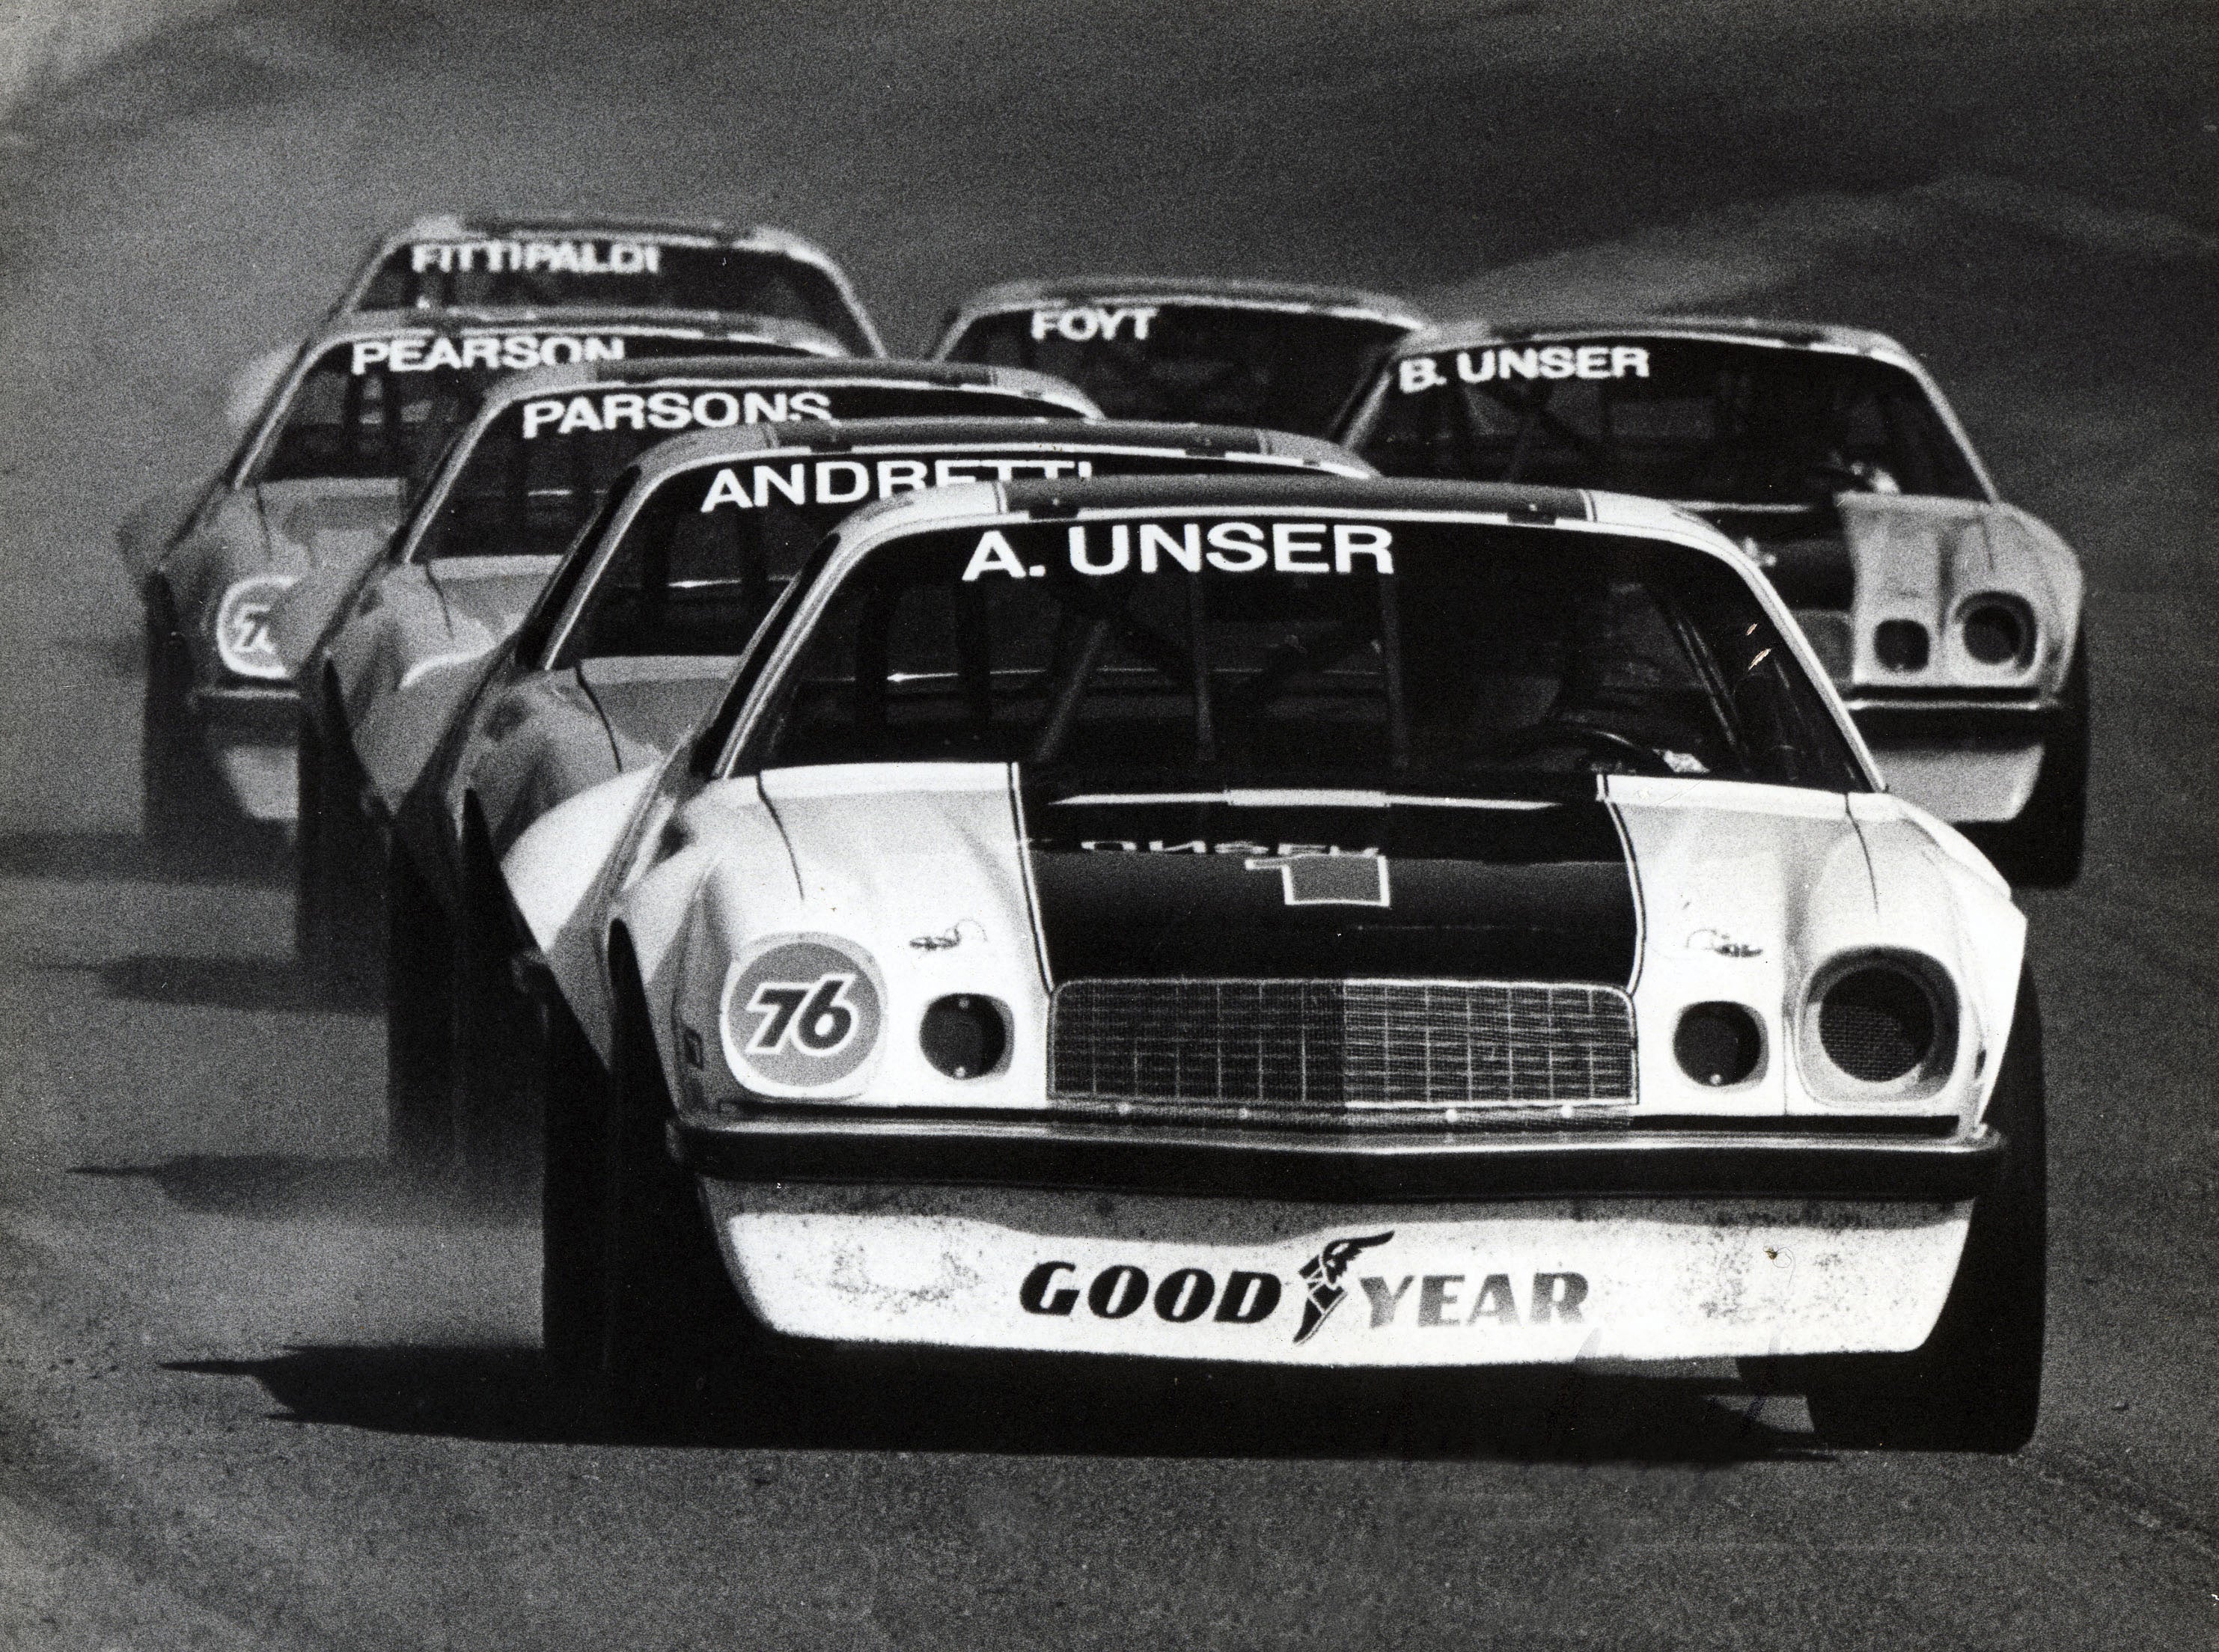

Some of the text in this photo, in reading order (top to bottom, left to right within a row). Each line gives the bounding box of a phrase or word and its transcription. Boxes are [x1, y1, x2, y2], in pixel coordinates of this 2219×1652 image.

[411, 239, 662, 274] FITTIPALDI
[1031, 308, 1158, 340] FOYT
[352, 337, 625, 375] PEARSON
[1398, 346, 1650, 394] B. UNSER
[523, 391, 832, 439] PARSONS
[962, 523, 1394, 581] A. UNSER
[751, 975, 855, 1054] 76
[1019, 1261, 1590, 1327] GOOD YEAR
